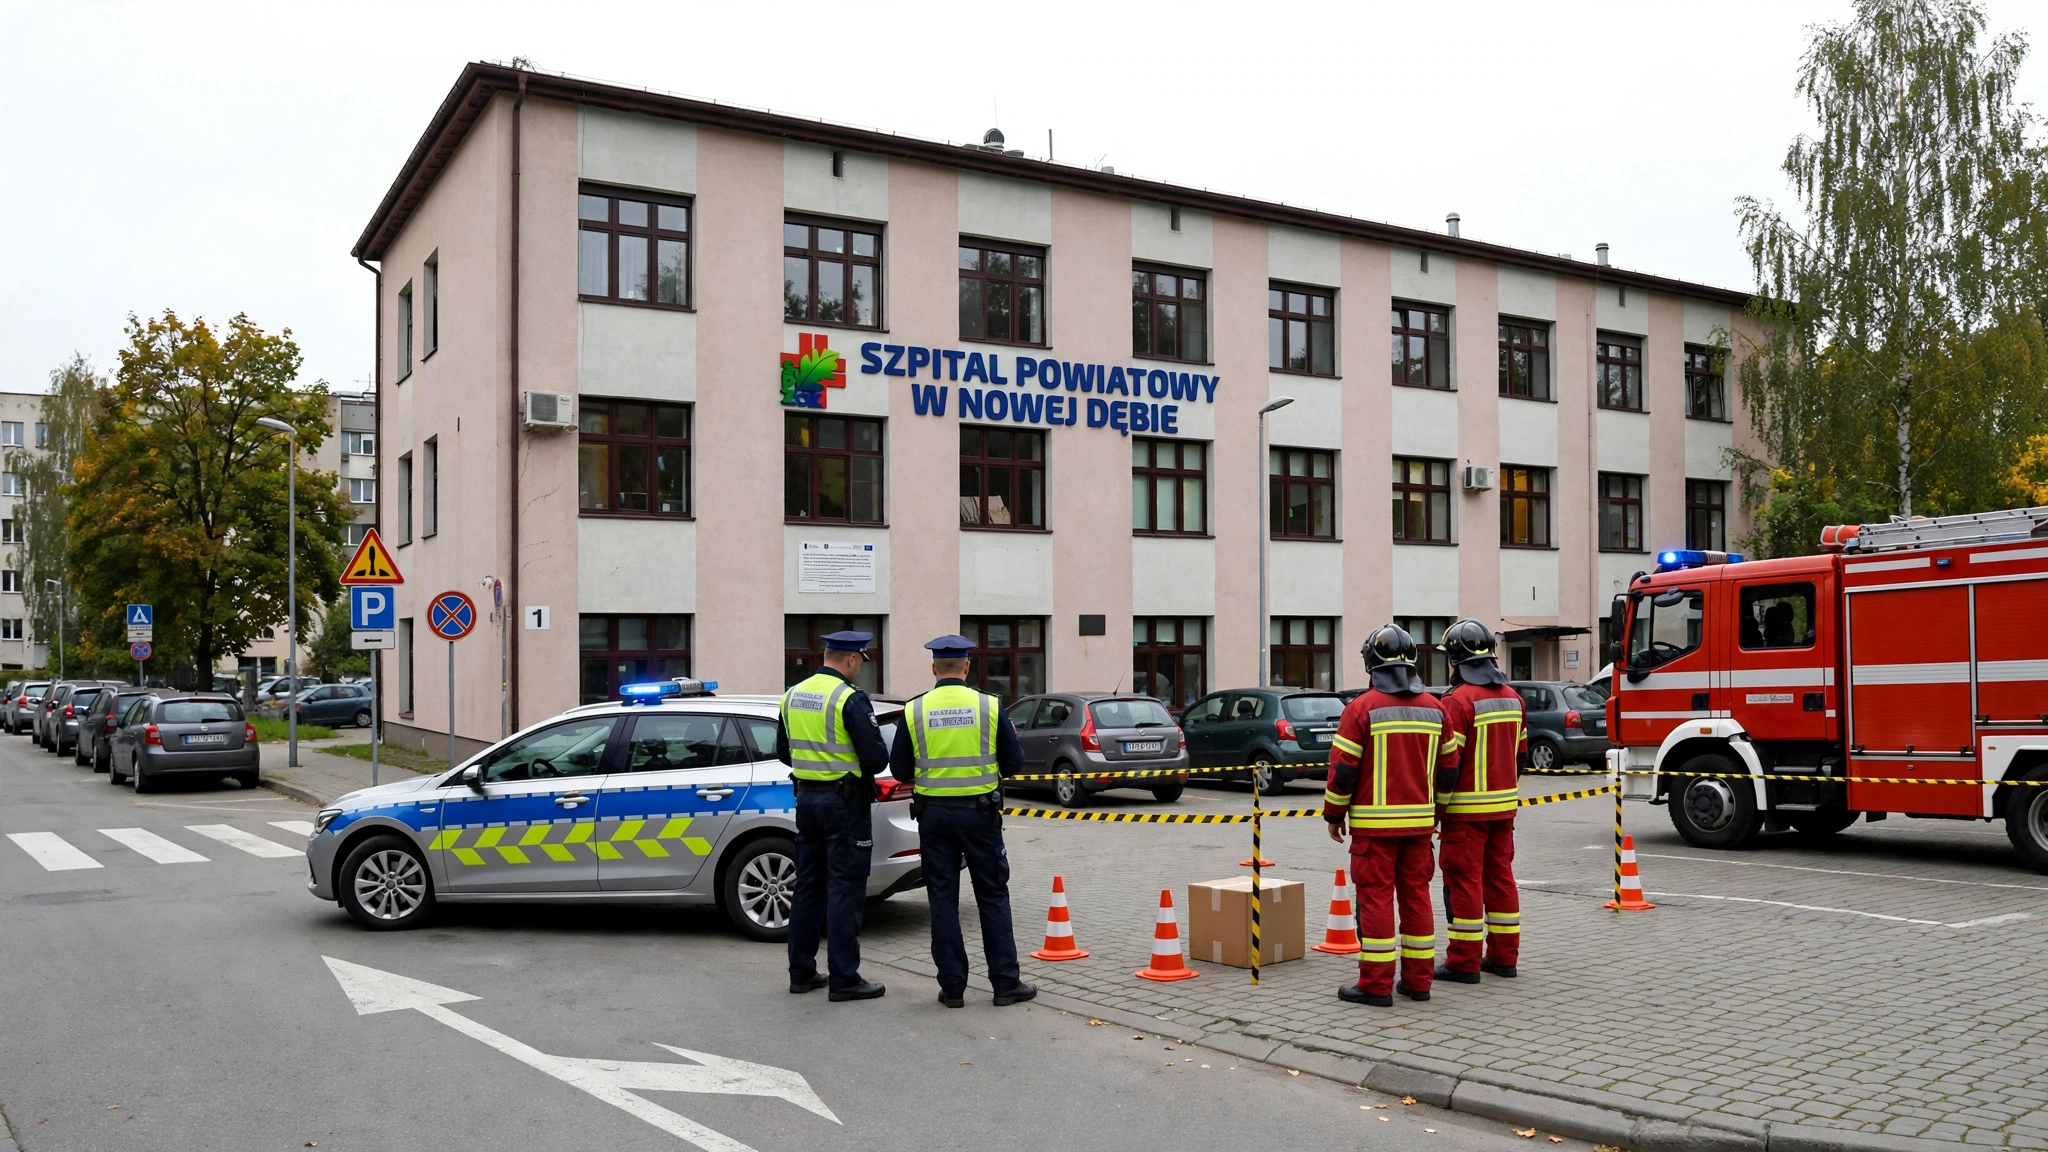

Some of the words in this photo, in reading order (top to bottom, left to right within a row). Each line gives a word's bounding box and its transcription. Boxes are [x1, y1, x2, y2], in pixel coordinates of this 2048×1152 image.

[861, 342, 1008, 385] SZPITAL
[1016, 356, 1221, 404] POWIATOWY
[911, 383, 949, 417] W
[958, 387, 1077, 427] NOWEJ
[1086, 397, 1179, 437] DĘBIE
[361, 591, 386, 626] P
[532, 608, 542, 628] 1
